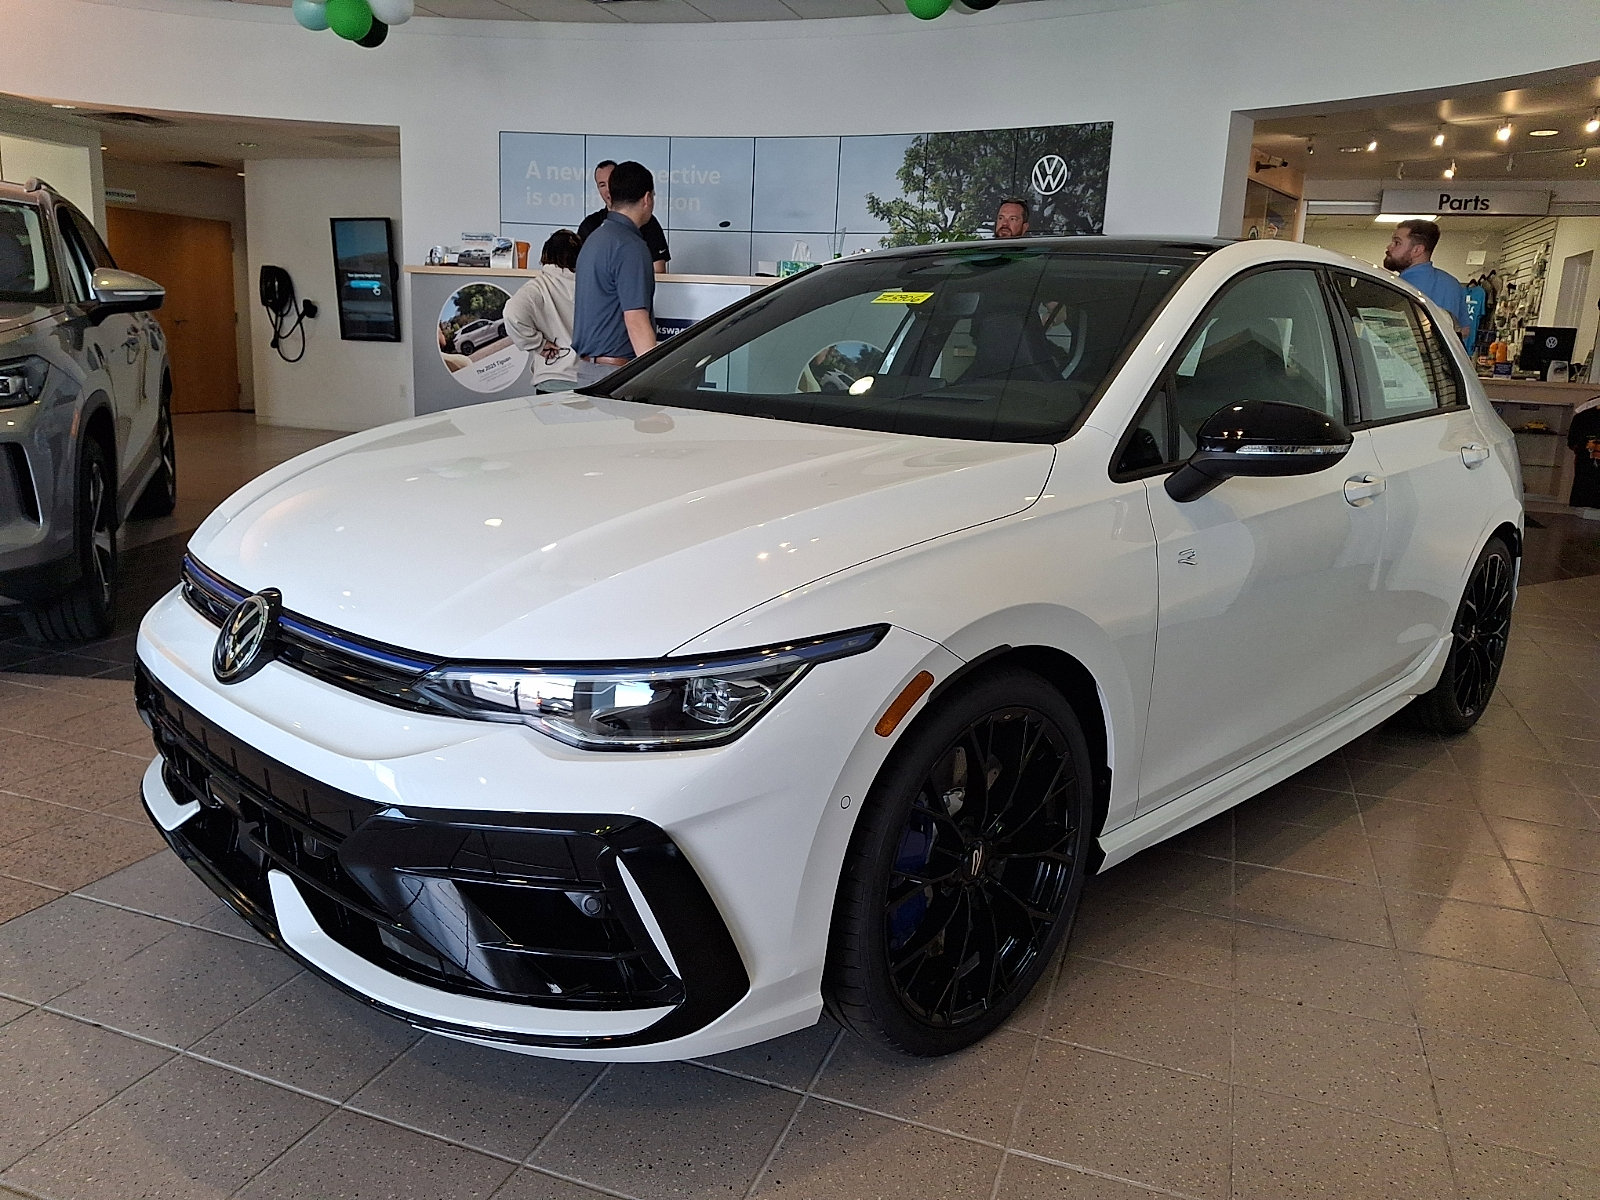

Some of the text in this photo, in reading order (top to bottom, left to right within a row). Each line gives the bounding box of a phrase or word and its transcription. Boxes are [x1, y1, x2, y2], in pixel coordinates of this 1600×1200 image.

[525, 160, 720, 186] A new ective
[525, 186, 542, 206] is
[549, 191, 575, 207] on
[1438, 193, 1490, 211] Parts
